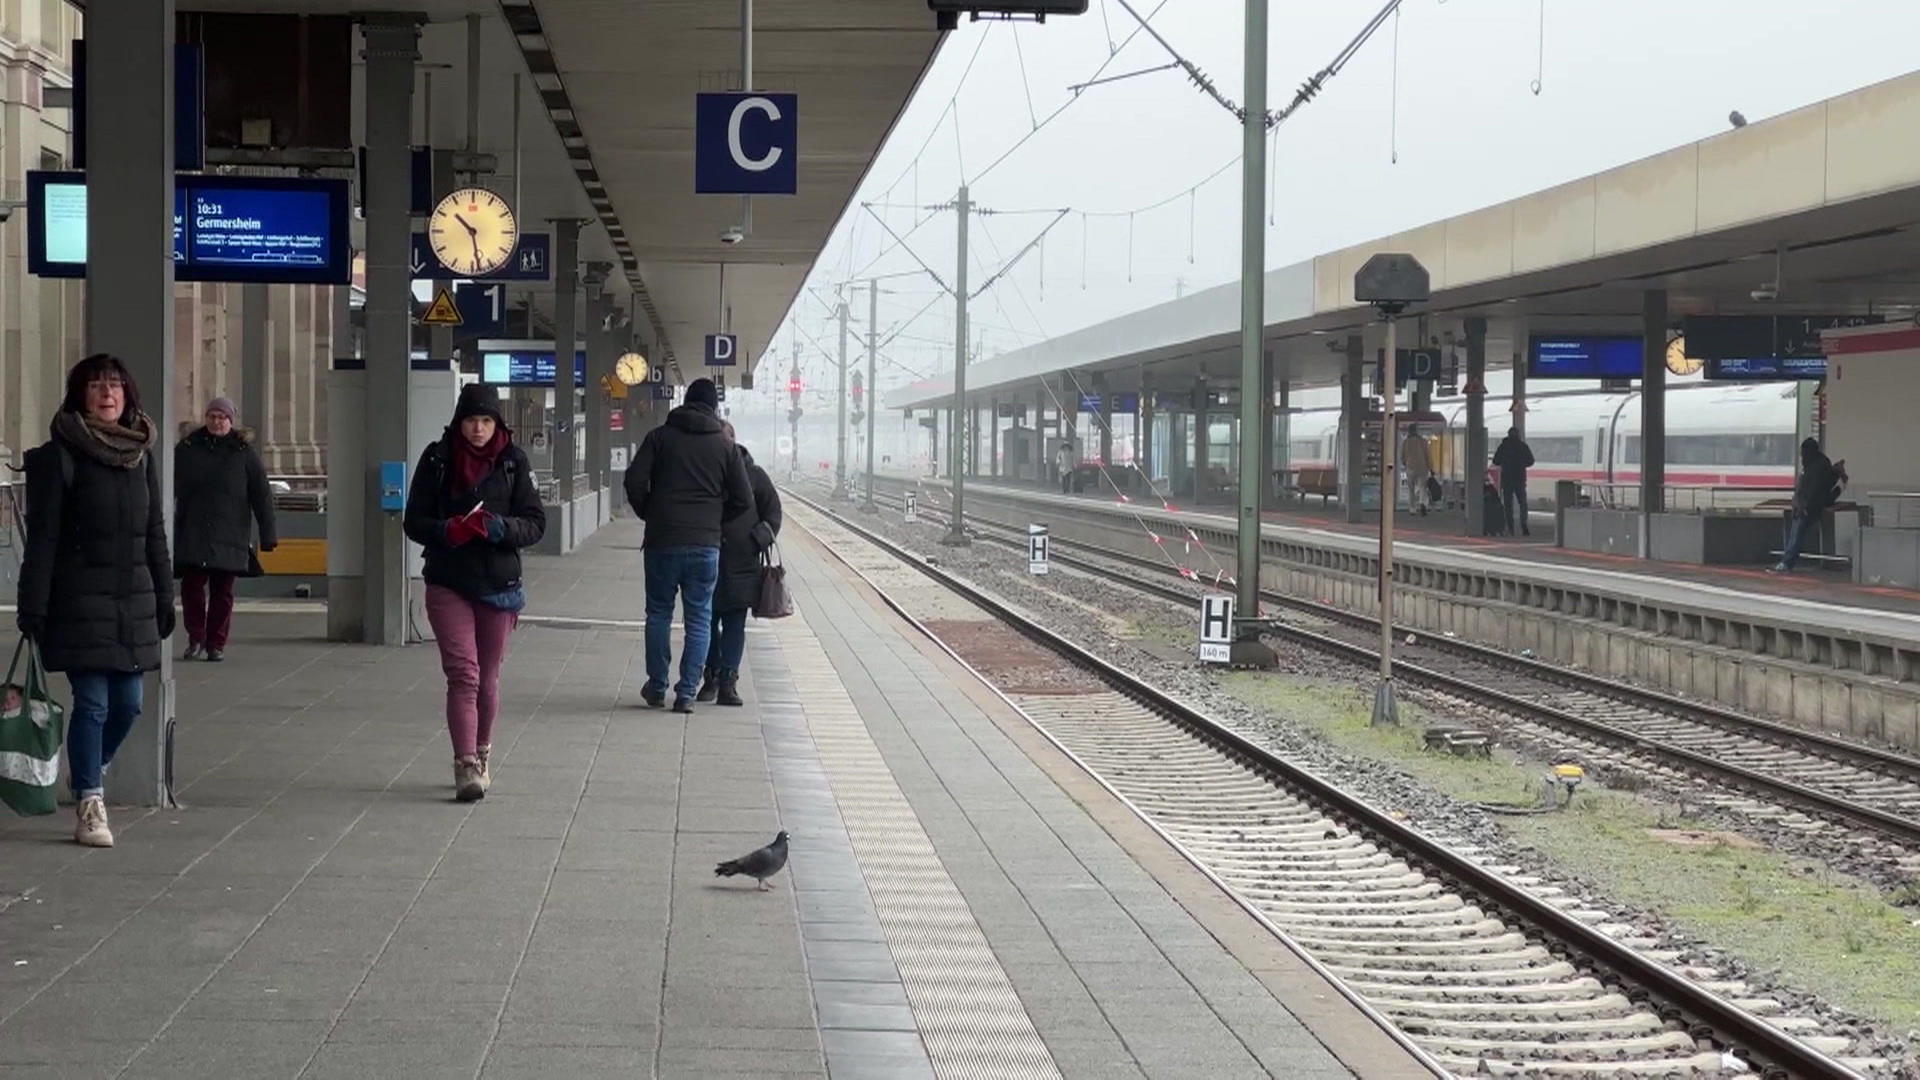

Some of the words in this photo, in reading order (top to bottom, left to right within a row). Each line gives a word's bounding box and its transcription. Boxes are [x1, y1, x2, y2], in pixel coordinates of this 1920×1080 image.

[727, 97, 783, 171] C
[197, 204, 223, 214] 10:31
[196, 217, 261, 230] Germersheim
[484, 285, 499, 321] 1
[714, 336, 732, 359] D
[1415, 352, 1432, 376] D
[1032, 537, 1046, 560] H
[1204, 599, 1230, 638] H
